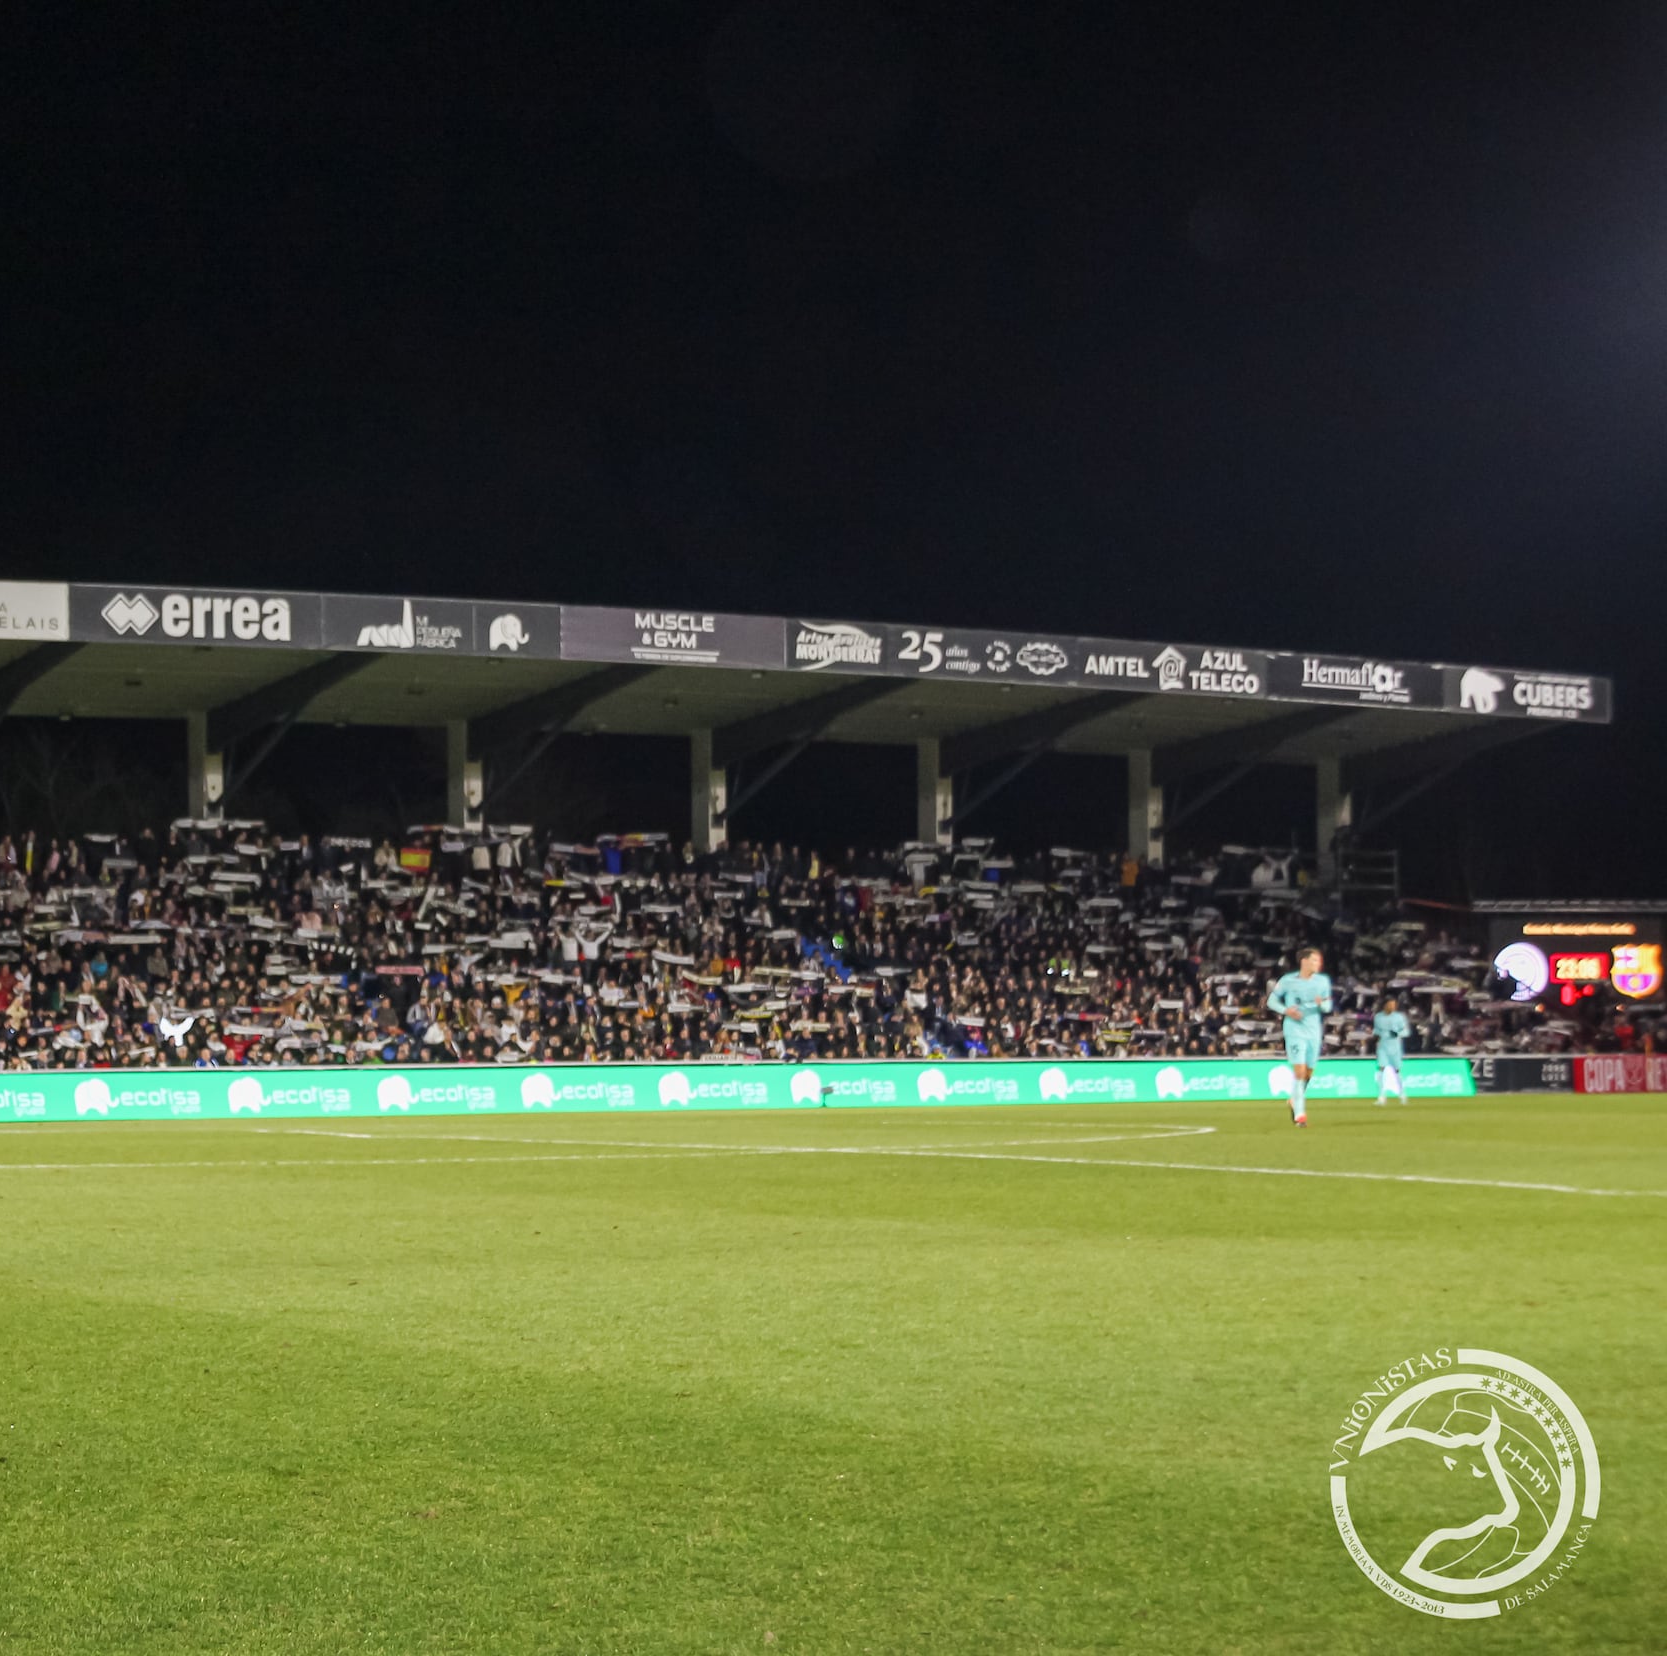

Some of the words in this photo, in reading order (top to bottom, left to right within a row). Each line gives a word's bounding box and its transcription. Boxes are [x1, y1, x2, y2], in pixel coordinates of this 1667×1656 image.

[161, 594, 291, 641] errea
[634, 613, 715, 632] MUSCLE
[653, 633, 697, 649] GYM
[898, 630, 943, 673] 25
[945, 659, 981, 675] contigo
[1084, 655, 1150, 678] AMTEL
[1200, 650, 1248, 672] AZUL
[1189, 671, 1259, 694] TELECO
[1513, 681, 1591, 709] CUBERS
[1073, 1075, 1136, 1093] ecotisa
[1584, 1059, 1626, 1092] COPA
[418, 1084, 495, 1102] ecotisa
[562, 1082, 634, 1099] ecotisa
[698, 1080, 767, 1098] ecotisa
[953, 1077, 1018, 1094] ecotisa
[120, 1088, 200, 1106] ecotisa
[272, 1086, 350, 1104] ecotisa
